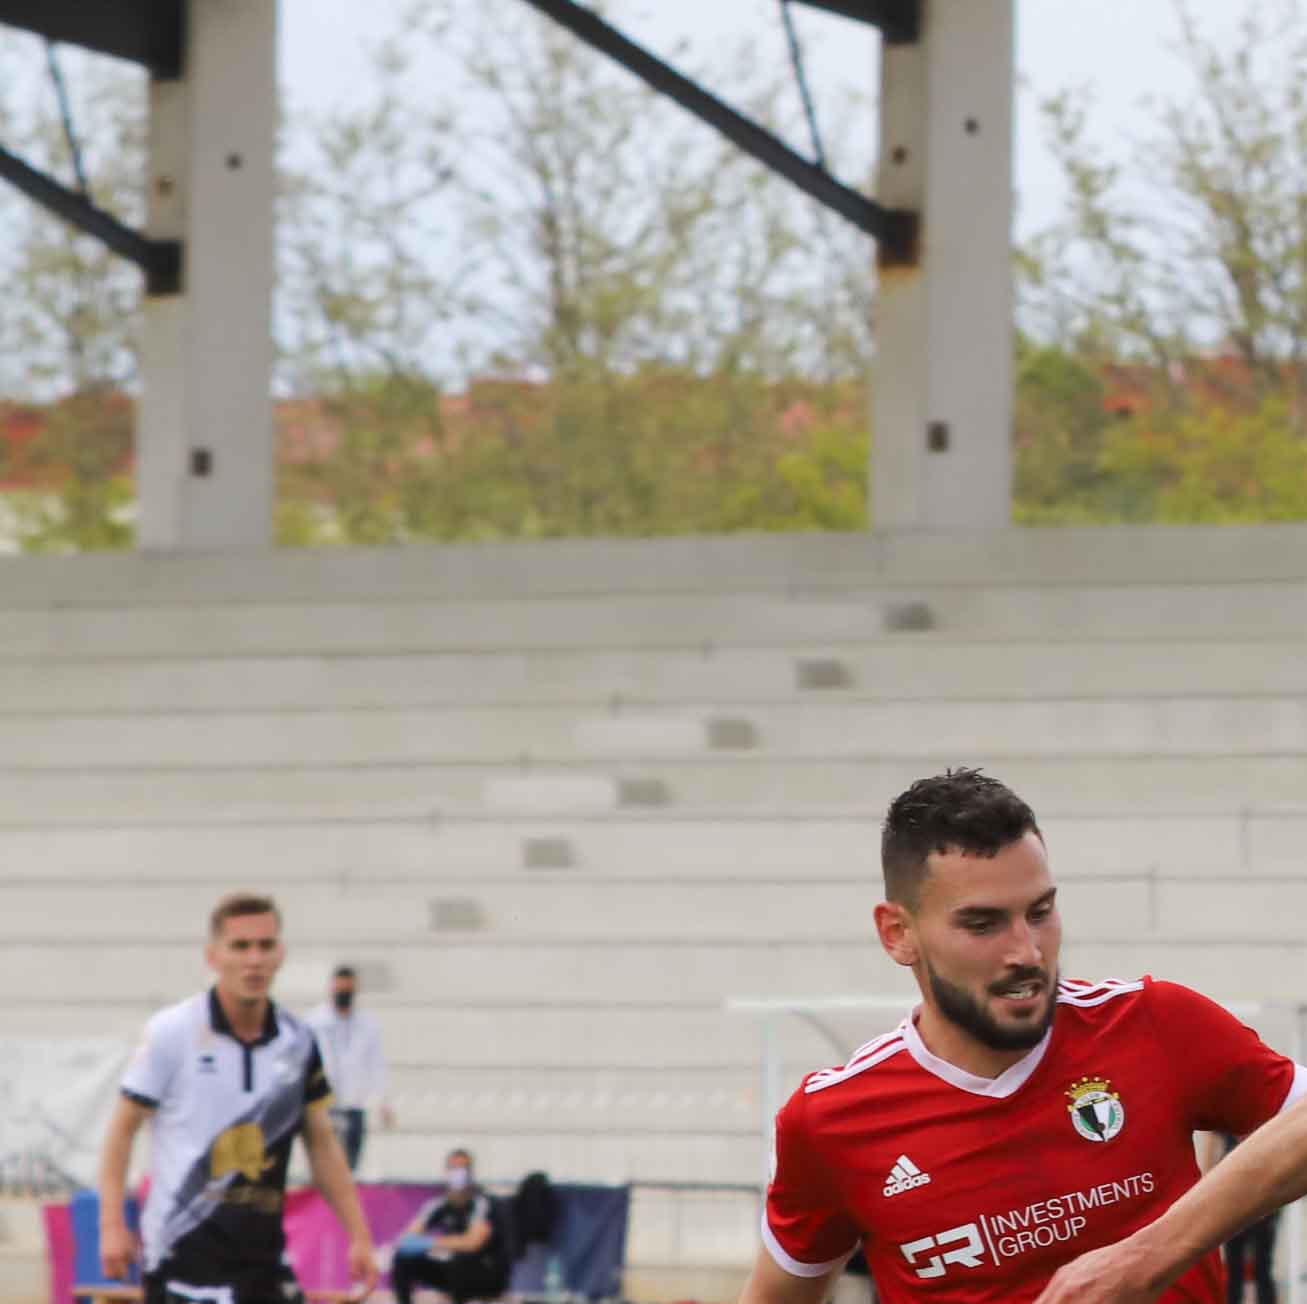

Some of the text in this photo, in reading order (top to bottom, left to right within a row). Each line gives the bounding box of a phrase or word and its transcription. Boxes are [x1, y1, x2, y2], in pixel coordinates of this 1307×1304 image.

[882, 1172, 932, 1198] adidas
[990, 1172, 1156, 1237] INVESTMENTS
[998, 1217, 1087, 1258] GROUP
